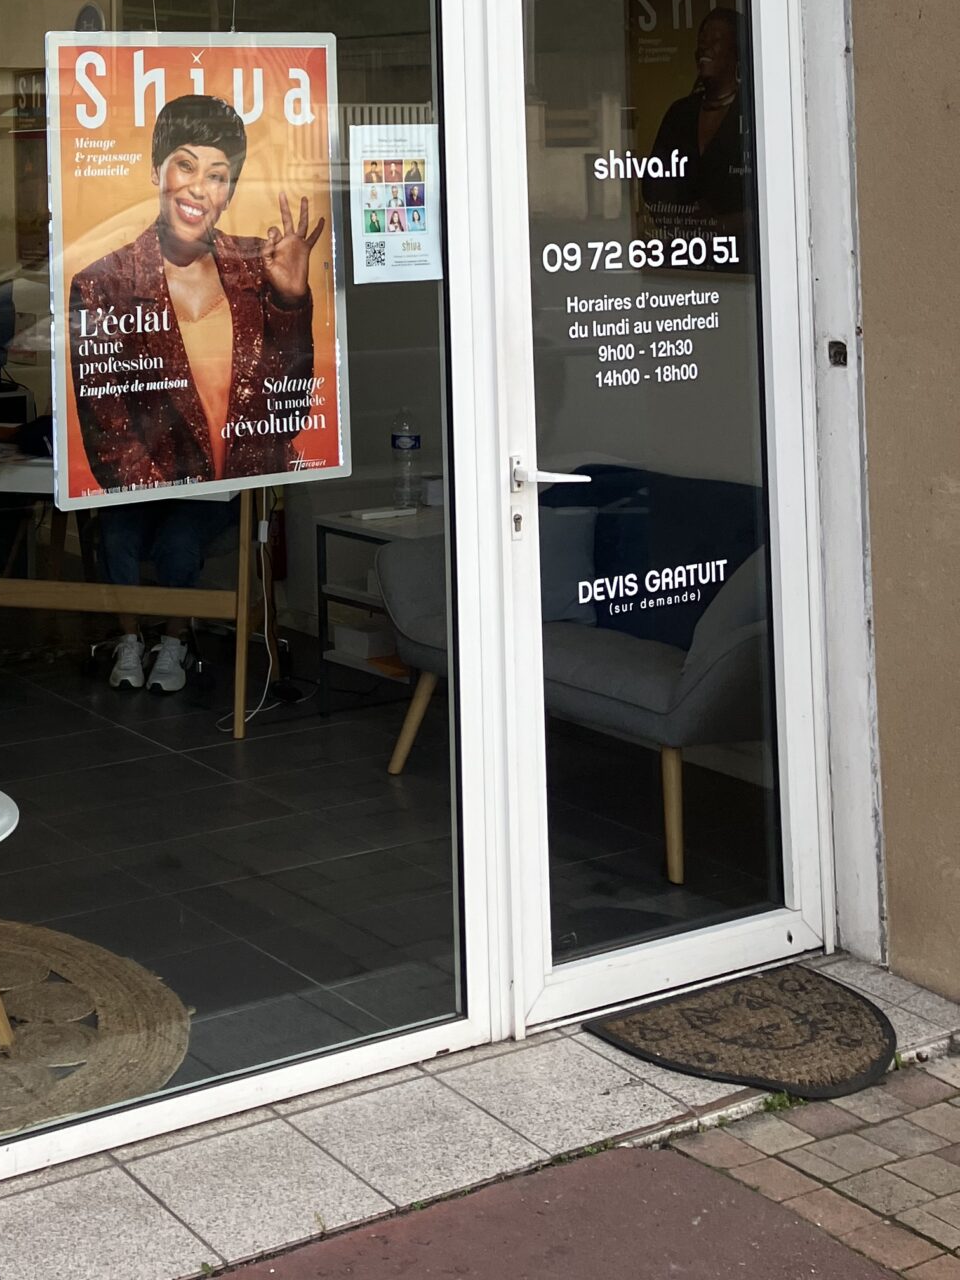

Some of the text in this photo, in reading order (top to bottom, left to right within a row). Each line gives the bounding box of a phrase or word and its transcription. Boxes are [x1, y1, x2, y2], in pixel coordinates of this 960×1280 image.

[75, 49, 316, 130] Shiva
[74, 137, 116, 151] Ménage
[83, 164, 130, 177] domicile
[86, 152, 143, 166] repassage
[593, 149, 688, 180] shiva.fr
[542, 236, 739, 273] 09 72 63 20 51
[566, 294, 632, 314] Horaires
[568, 312, 720, 339] du lundi au vendredi
[598, 343, 635, 362] 9h00
[649, 339, 693, 358] 12h30
[79, 354, 164, 379] profession
[595, 368, 640, 387] 14h00
[654, 363, 698, 383] 18h00
[80, 376, 188, 399] Employé de maison
[262, 375, 325, 396] Solange
[267, 394, 326, 411] Un modèle
[578, 559, 728, 604] DEVIS GRATUIT
[609, 589, 701, 616] (sur demande)
